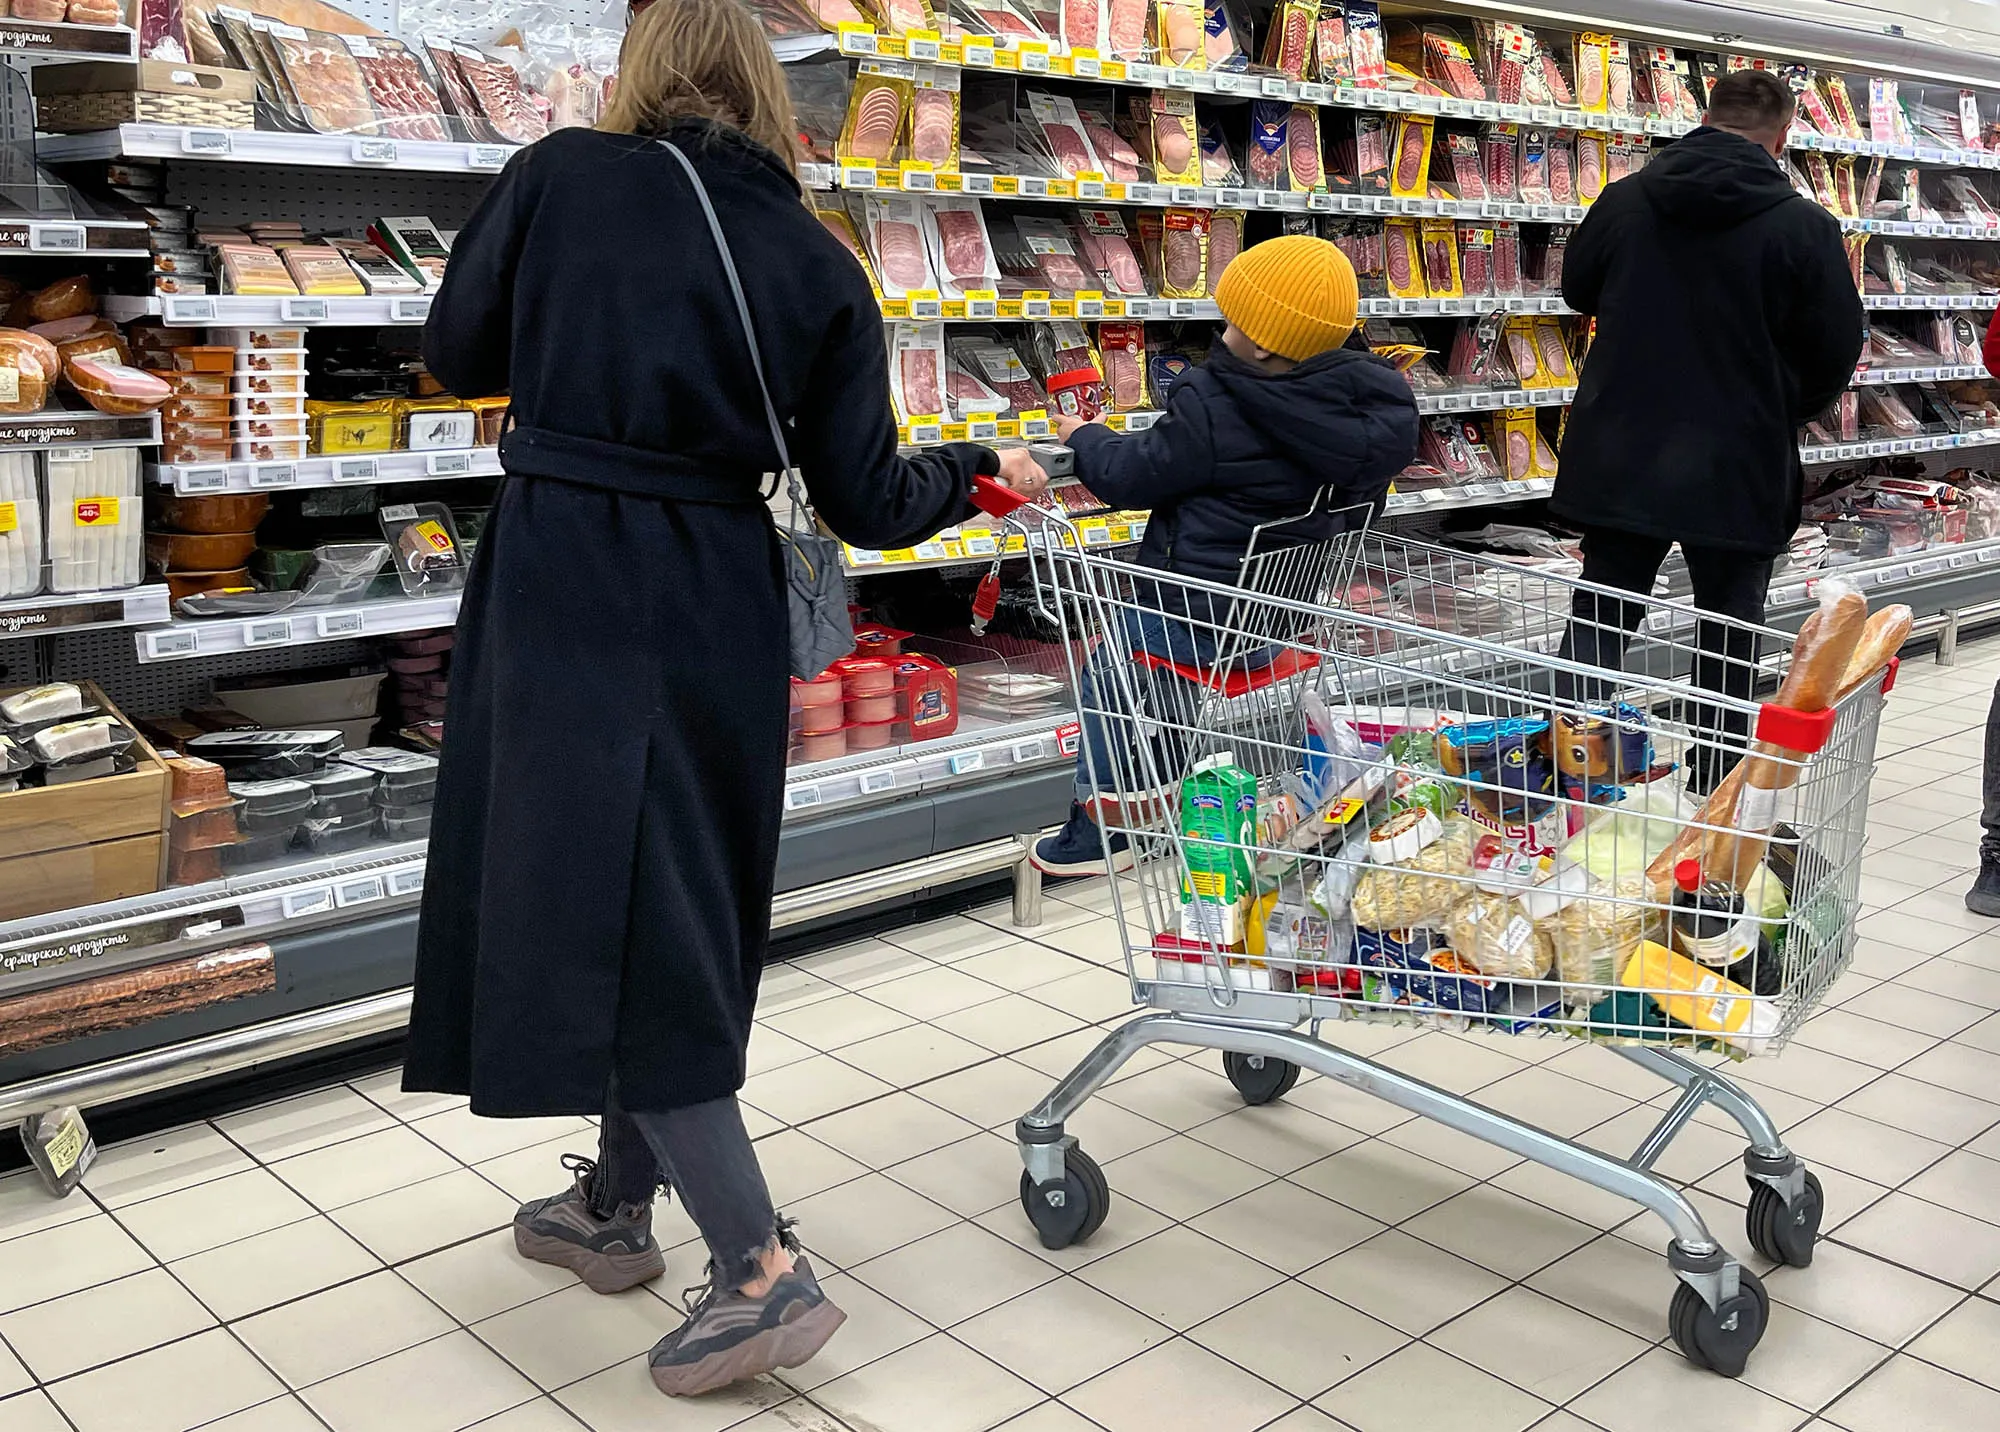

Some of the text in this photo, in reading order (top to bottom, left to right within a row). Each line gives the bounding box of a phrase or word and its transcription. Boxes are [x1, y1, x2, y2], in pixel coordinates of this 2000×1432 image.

[0, 31, 52, 48] родукты
[17, 427, 77, 443] продукты
[0, 614, 47, 632] одукты
[69, 933, 129, 959] продукты
